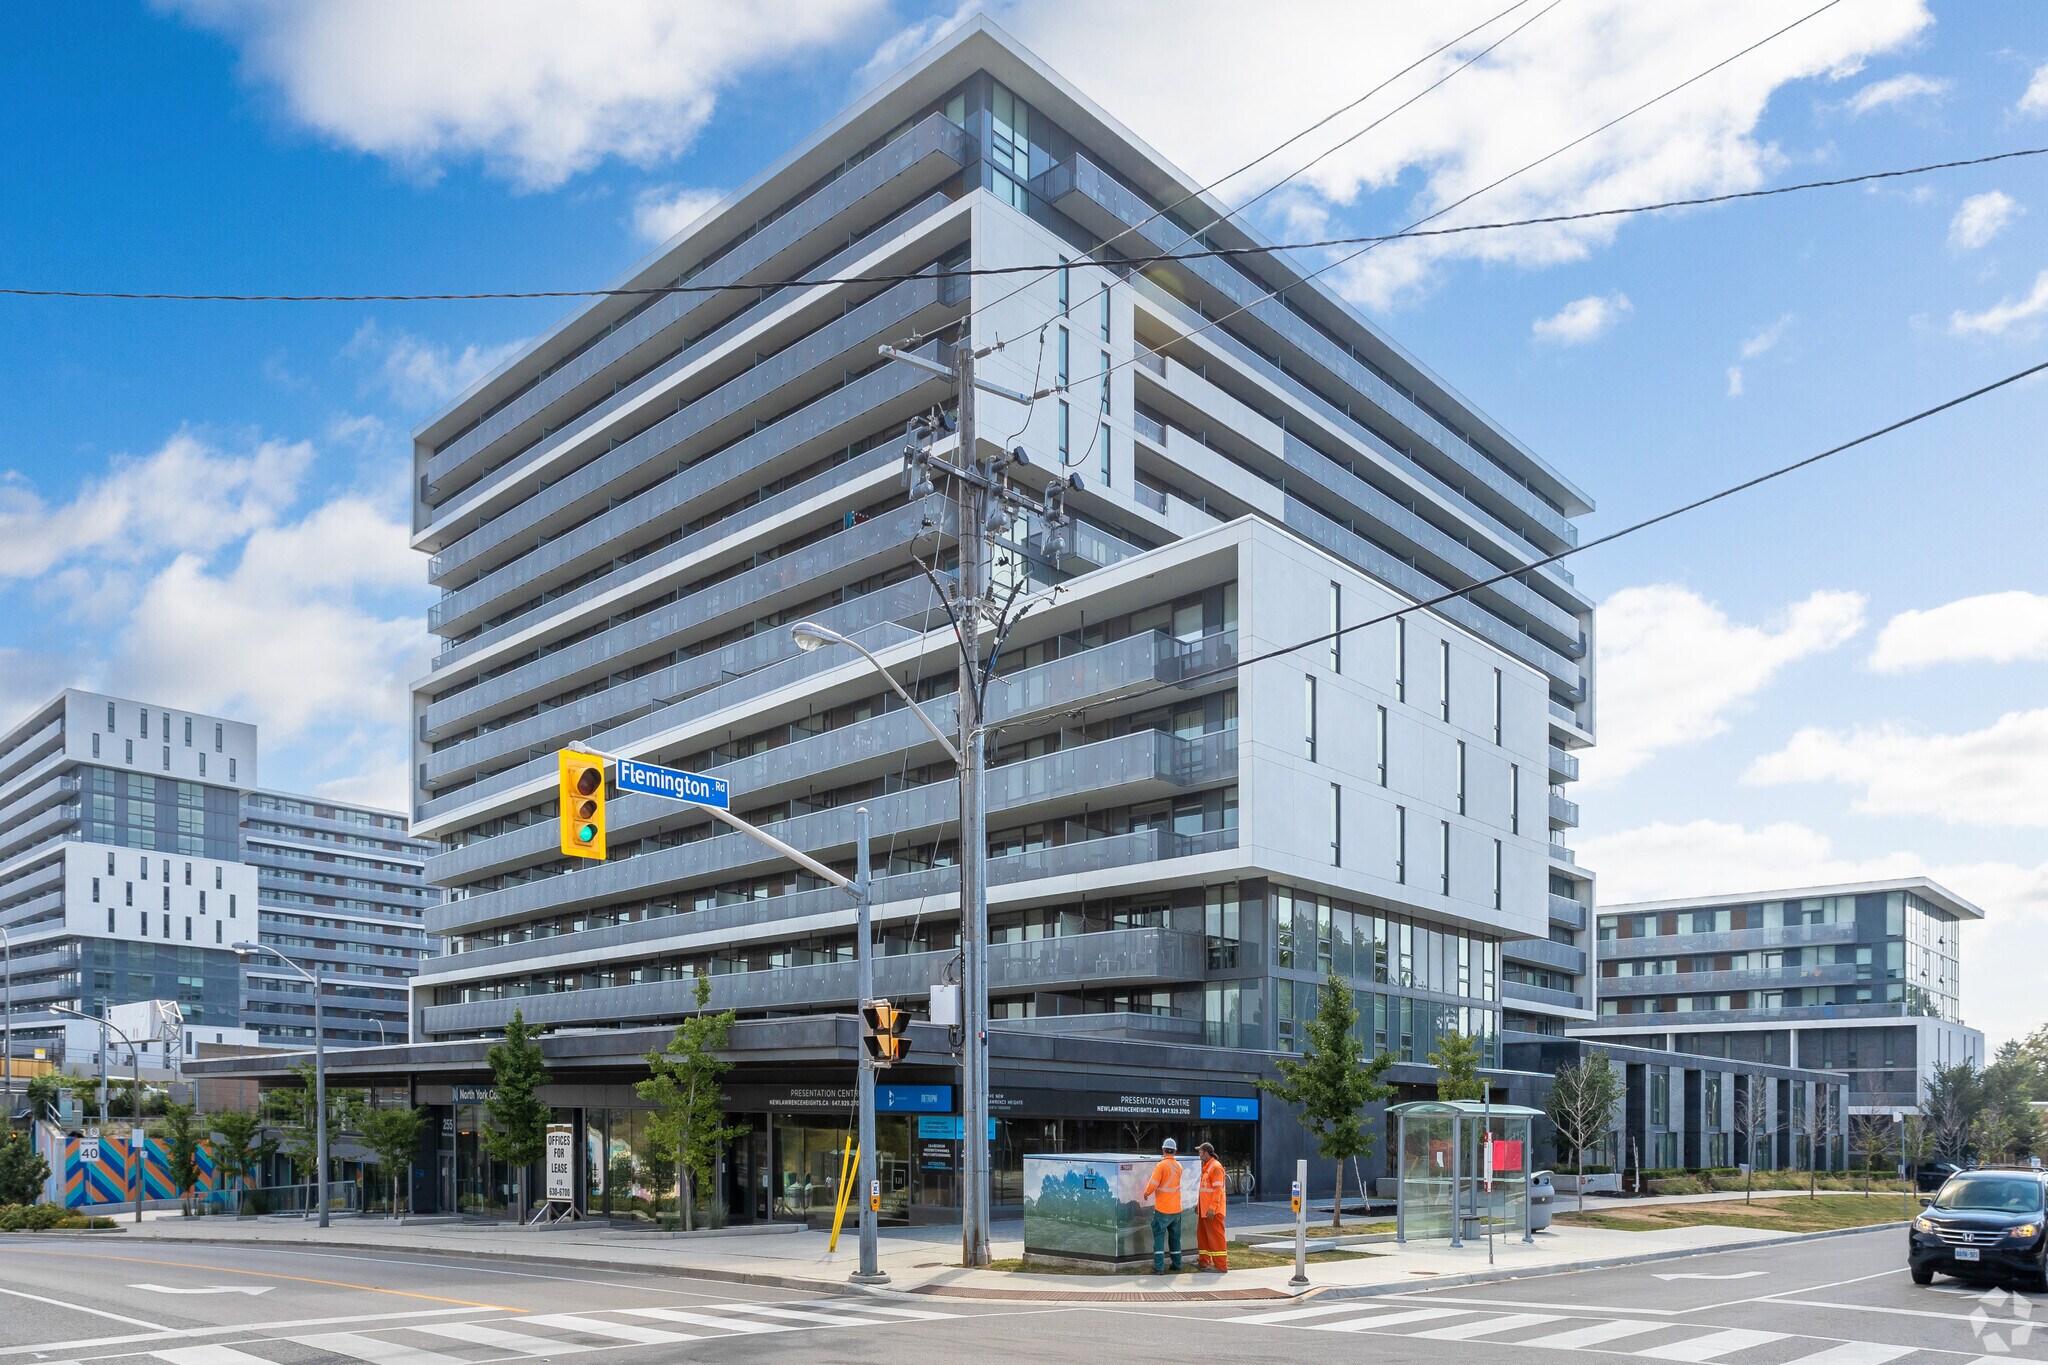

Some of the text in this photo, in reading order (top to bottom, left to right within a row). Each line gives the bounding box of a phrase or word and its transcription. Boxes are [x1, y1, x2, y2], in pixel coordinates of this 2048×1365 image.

[621, 762, 726, 799] Flemington Rd
[460, 1089, 475, 1099] North
[476, 1089, 489, 1100] York
[790, 1089, 860, 1099] PRESENTATION CENTR
[1120, 1095, 1190, 1107] PRESENTATION CENTRE
[1096, 1105, 1160, 1114] NEWLAWRENCEHEIGHTS.CA
[443, 1118, 453, 1130] 255
[548, 1135, 571, 1146] OFFICES
[81, 1148, 98, 1159] 40
[553, 1147, 565, 1158] FOR
[551, 1162, 568, 1174] LEASE
